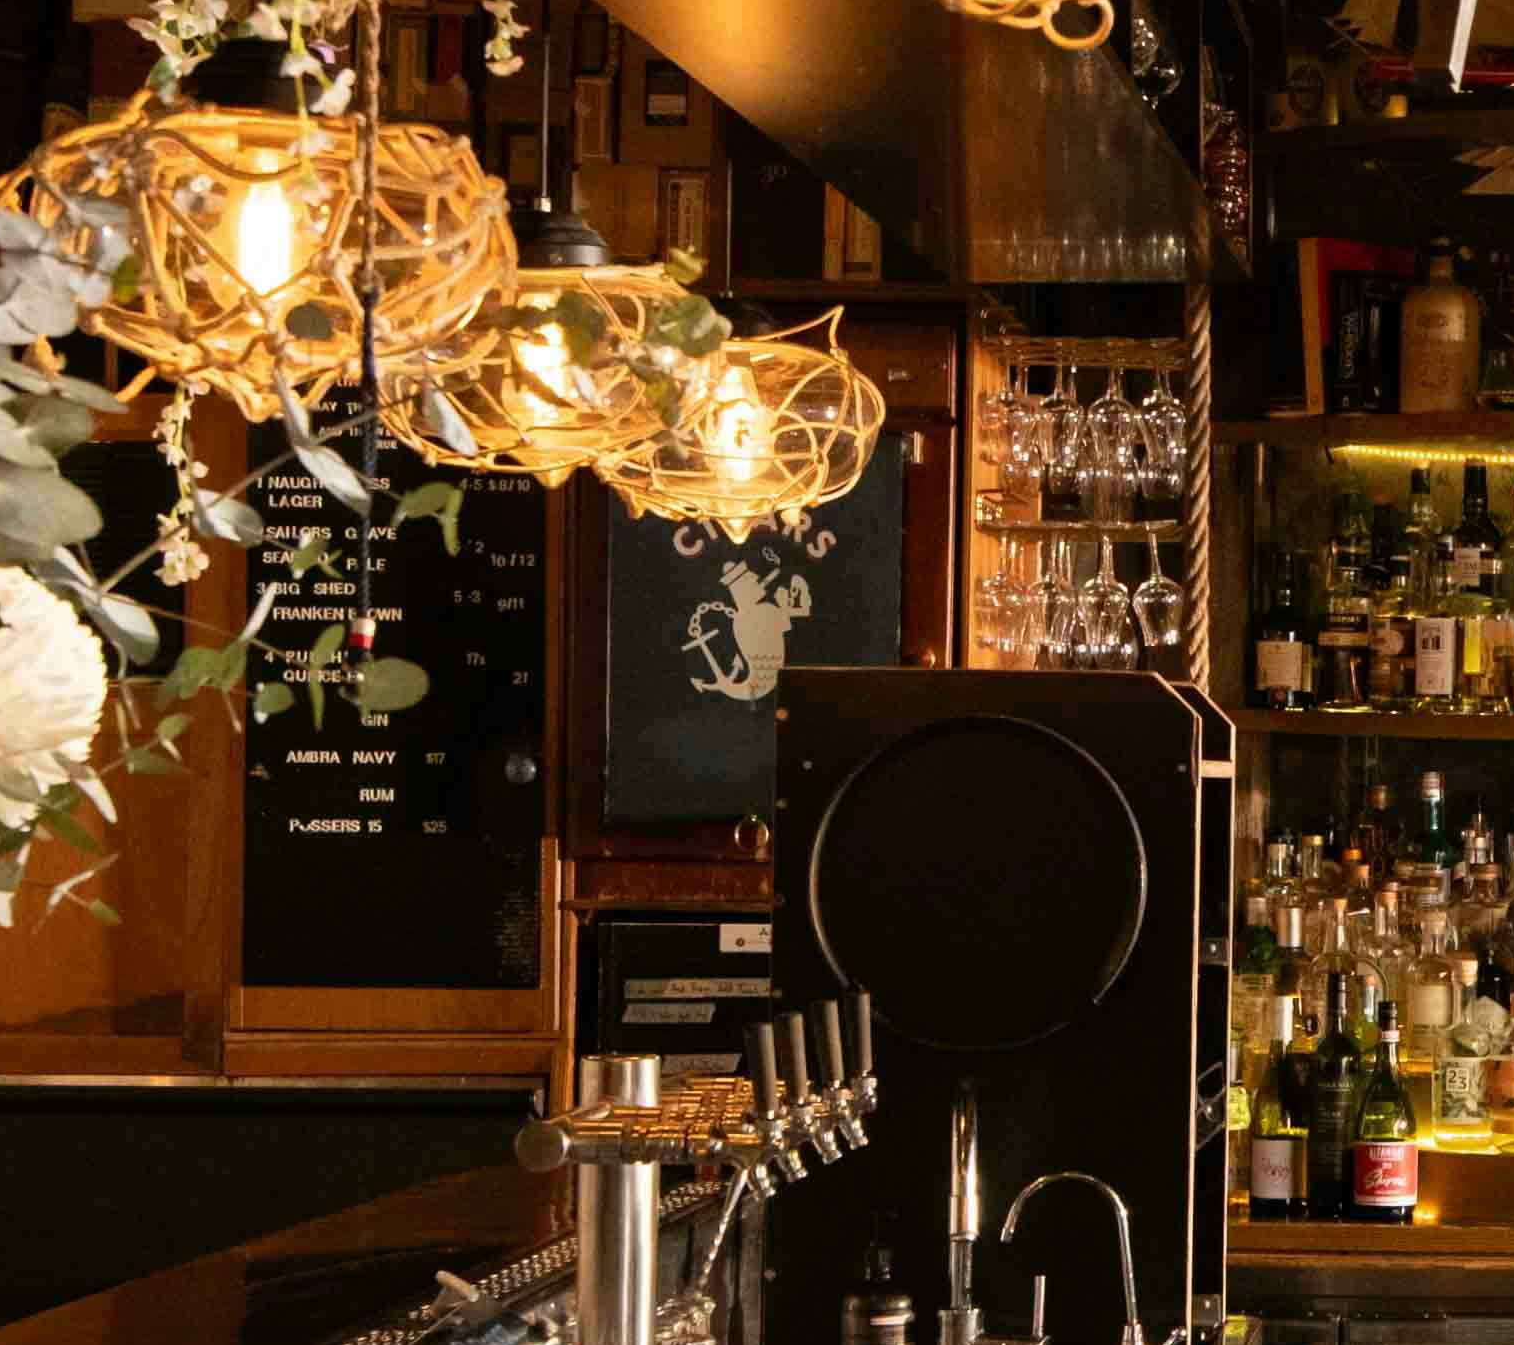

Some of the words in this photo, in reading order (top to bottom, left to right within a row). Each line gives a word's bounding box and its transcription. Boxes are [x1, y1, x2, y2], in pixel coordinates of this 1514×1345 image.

[269, 496, 323, 508] LAGER
[344, 526, 398, 540] GAVE
[672, 510, 837, 559] CIARS
[274, 583, 301, 596] BIG
[313, 583, 356, 596] SHED
[361, 714, 389, 727] GIN
[286, 751, 341, 764] AMBRA
[352, 751, 397, 764] NAVY
[359, 788, 395, 802] RUM
[367, 819, 383, 833] 15
